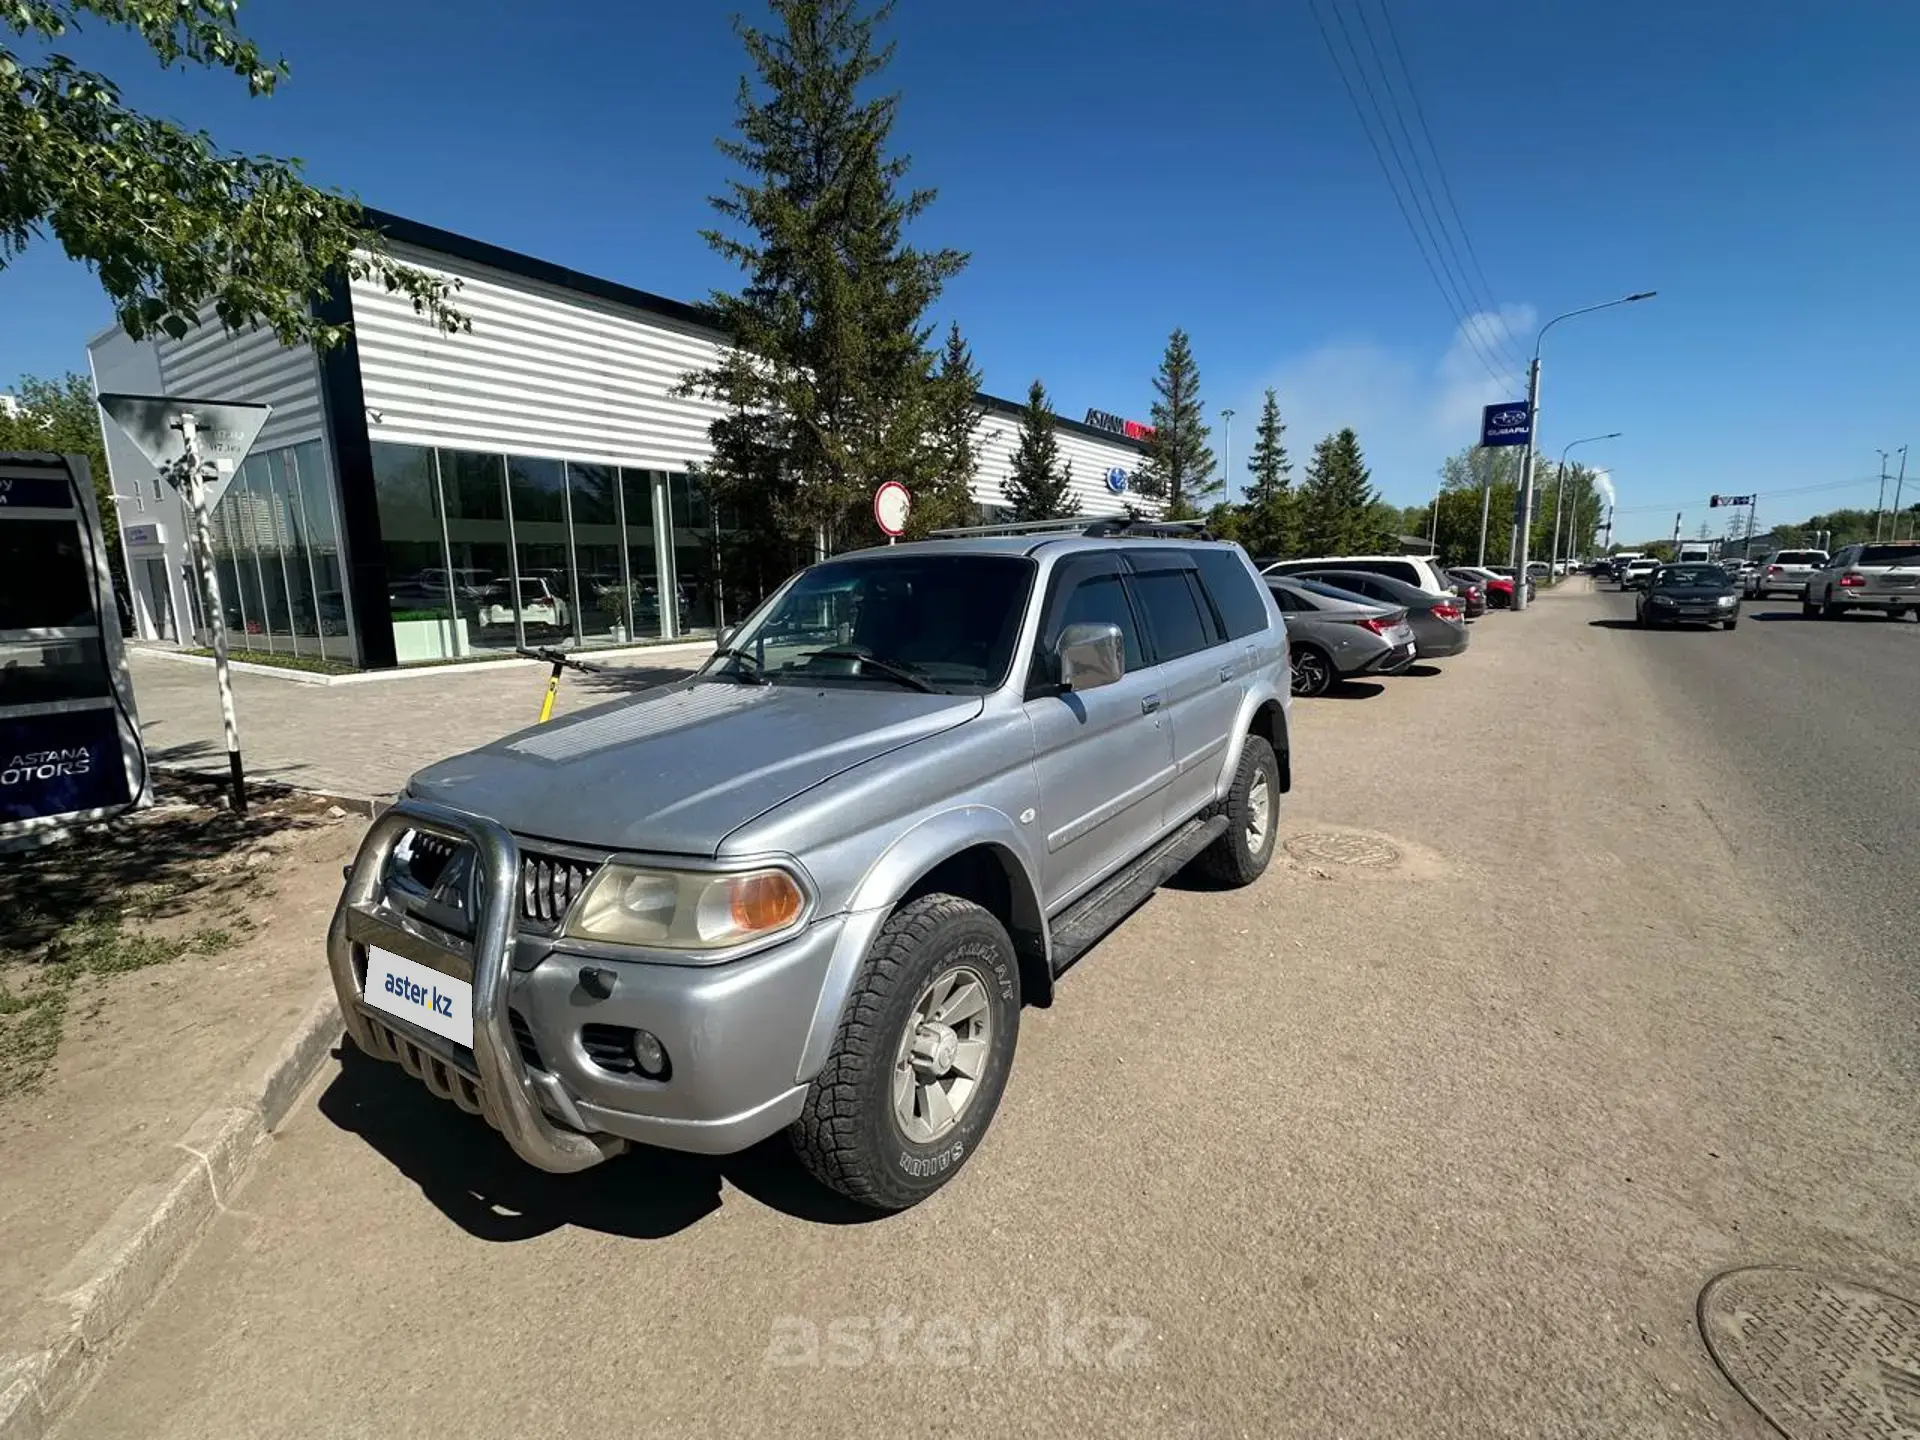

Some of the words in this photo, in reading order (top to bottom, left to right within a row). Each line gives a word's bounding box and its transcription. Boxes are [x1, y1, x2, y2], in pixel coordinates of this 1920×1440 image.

[1486, 426, 1530, 436] SUBARU
[9, 746, 90, 767] ASTANA
[0, 759, 90, 785] OTORS
[899, 1141, 964, 1177] SAILUN
